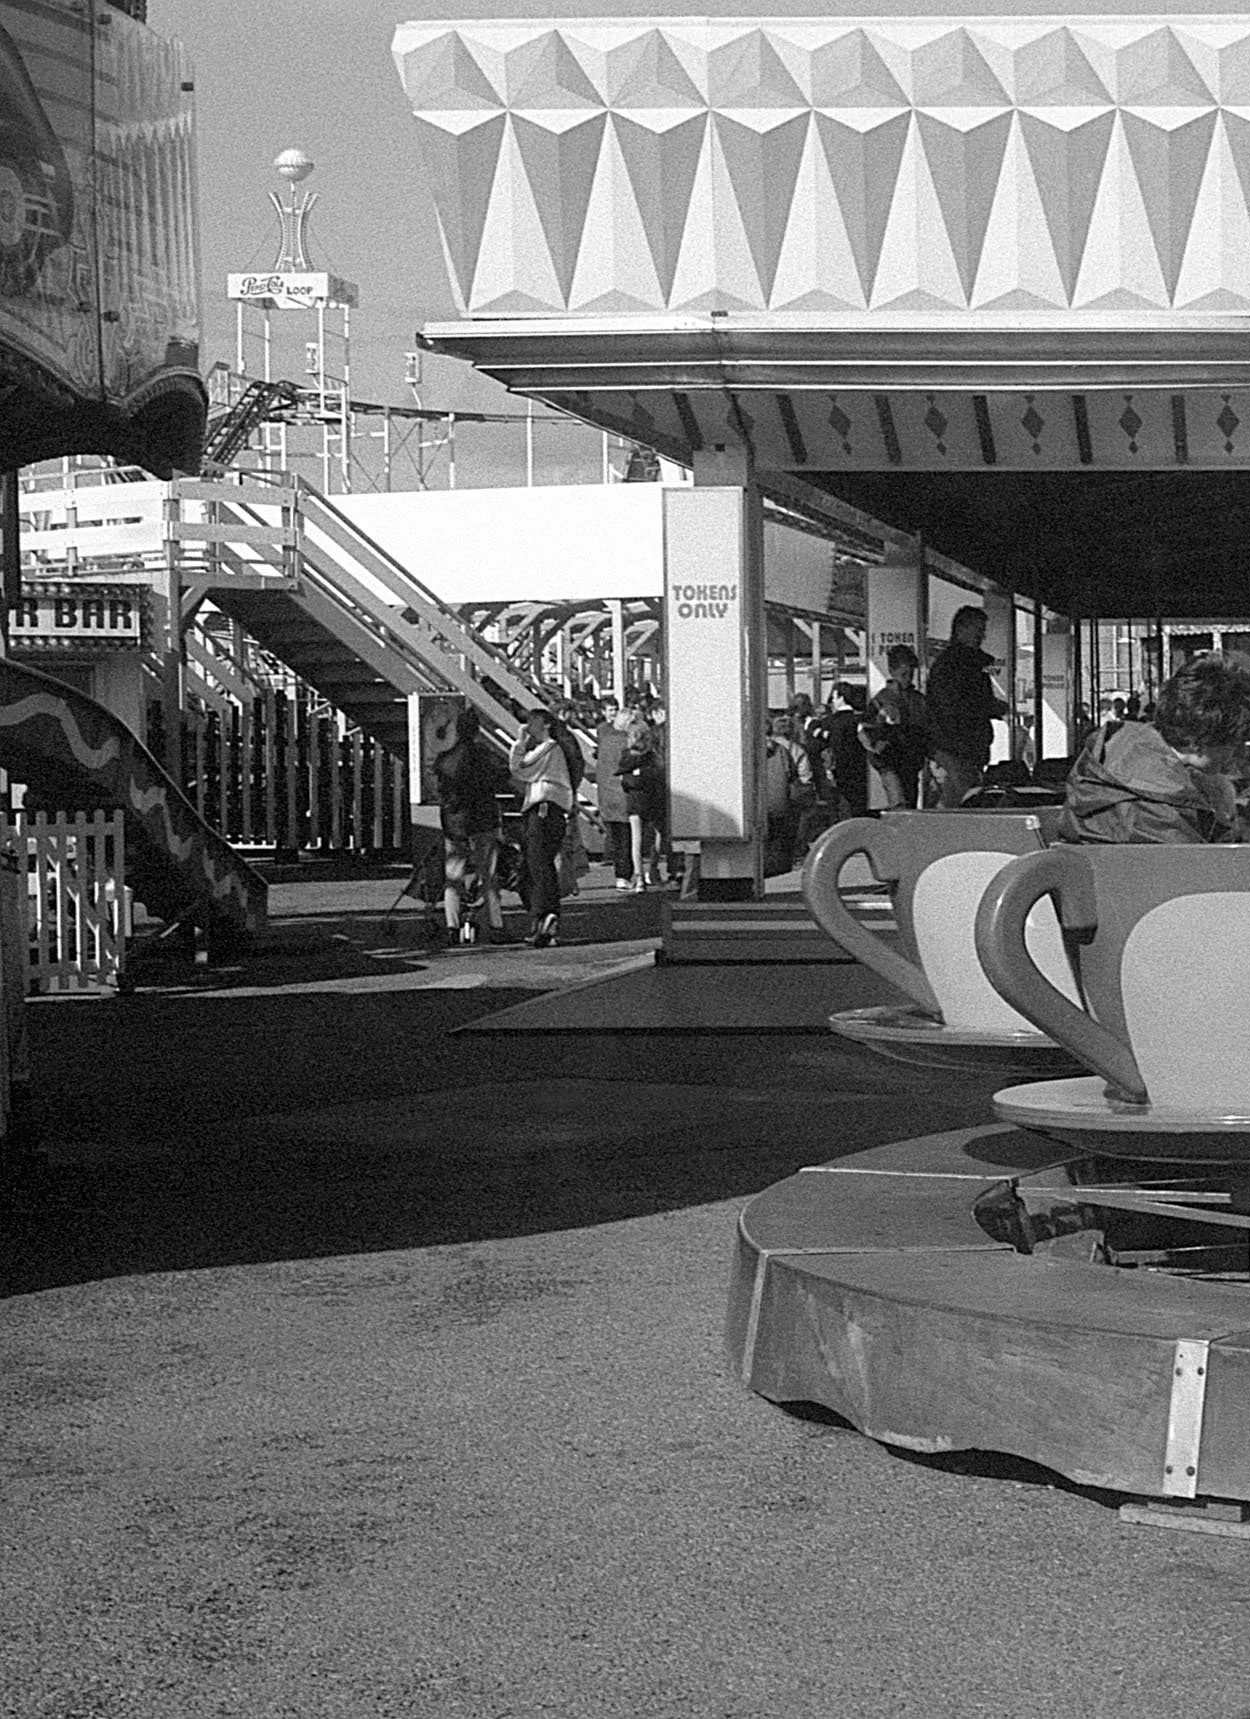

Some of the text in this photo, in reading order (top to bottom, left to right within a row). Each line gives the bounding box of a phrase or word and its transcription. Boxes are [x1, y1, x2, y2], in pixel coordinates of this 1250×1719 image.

[286, 286, 313, 295] LOOP
[672, 584, 737, 601] TOKENS
[55, 600, 132, 629] BAR
[678, 602, 728, 619] ONLY
[880, 632, 915, 644] TOKEN
